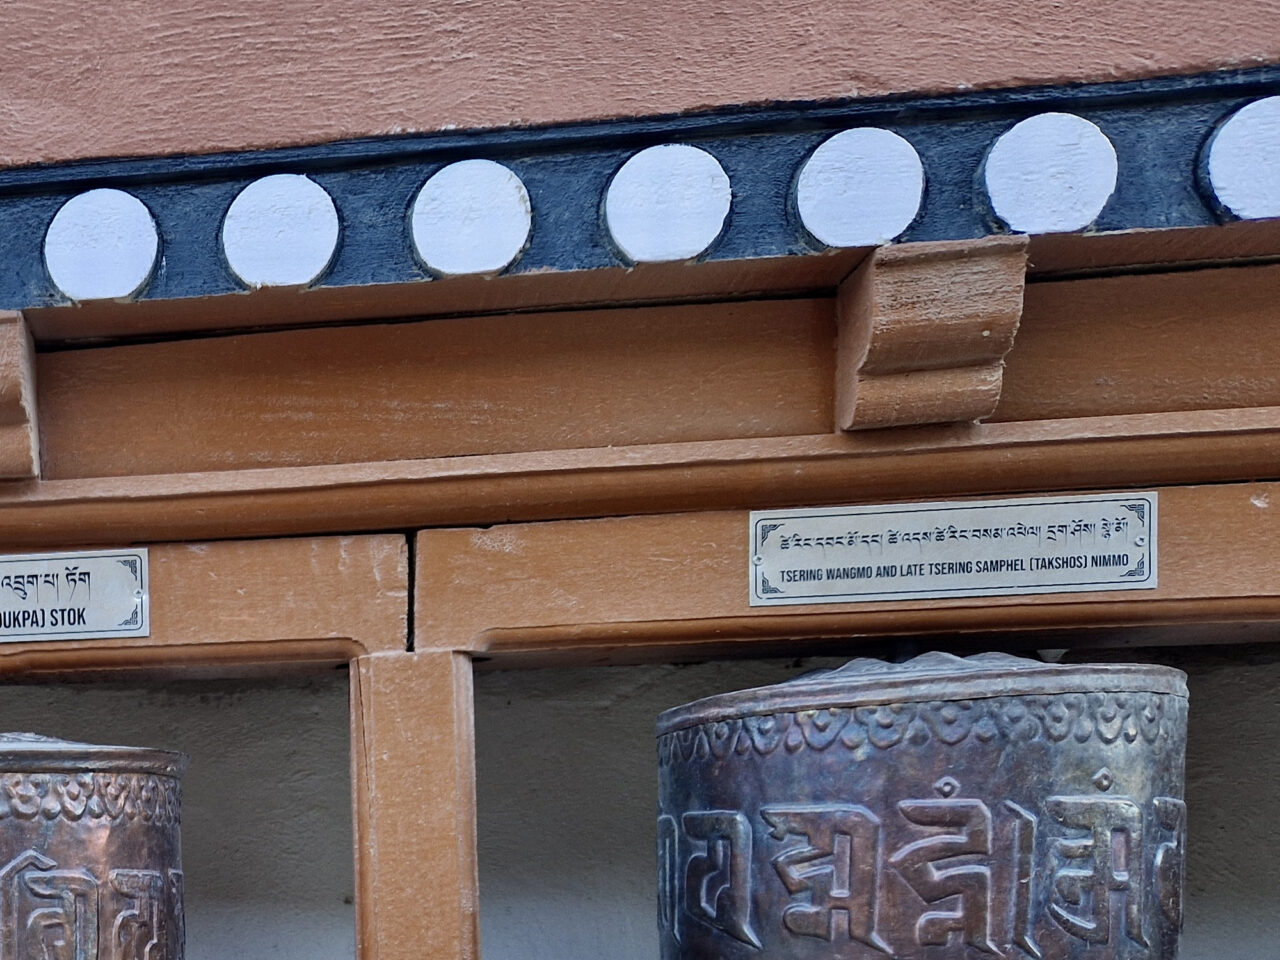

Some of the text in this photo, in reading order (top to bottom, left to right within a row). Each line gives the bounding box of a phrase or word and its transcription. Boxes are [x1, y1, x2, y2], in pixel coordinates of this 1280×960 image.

[780, 554, 1129, 582] TSERING WANGMO AND LATE TSERING SAMPHEL (TAKSHOS) NIMMO
[50, 608, 87, 626] STOK
